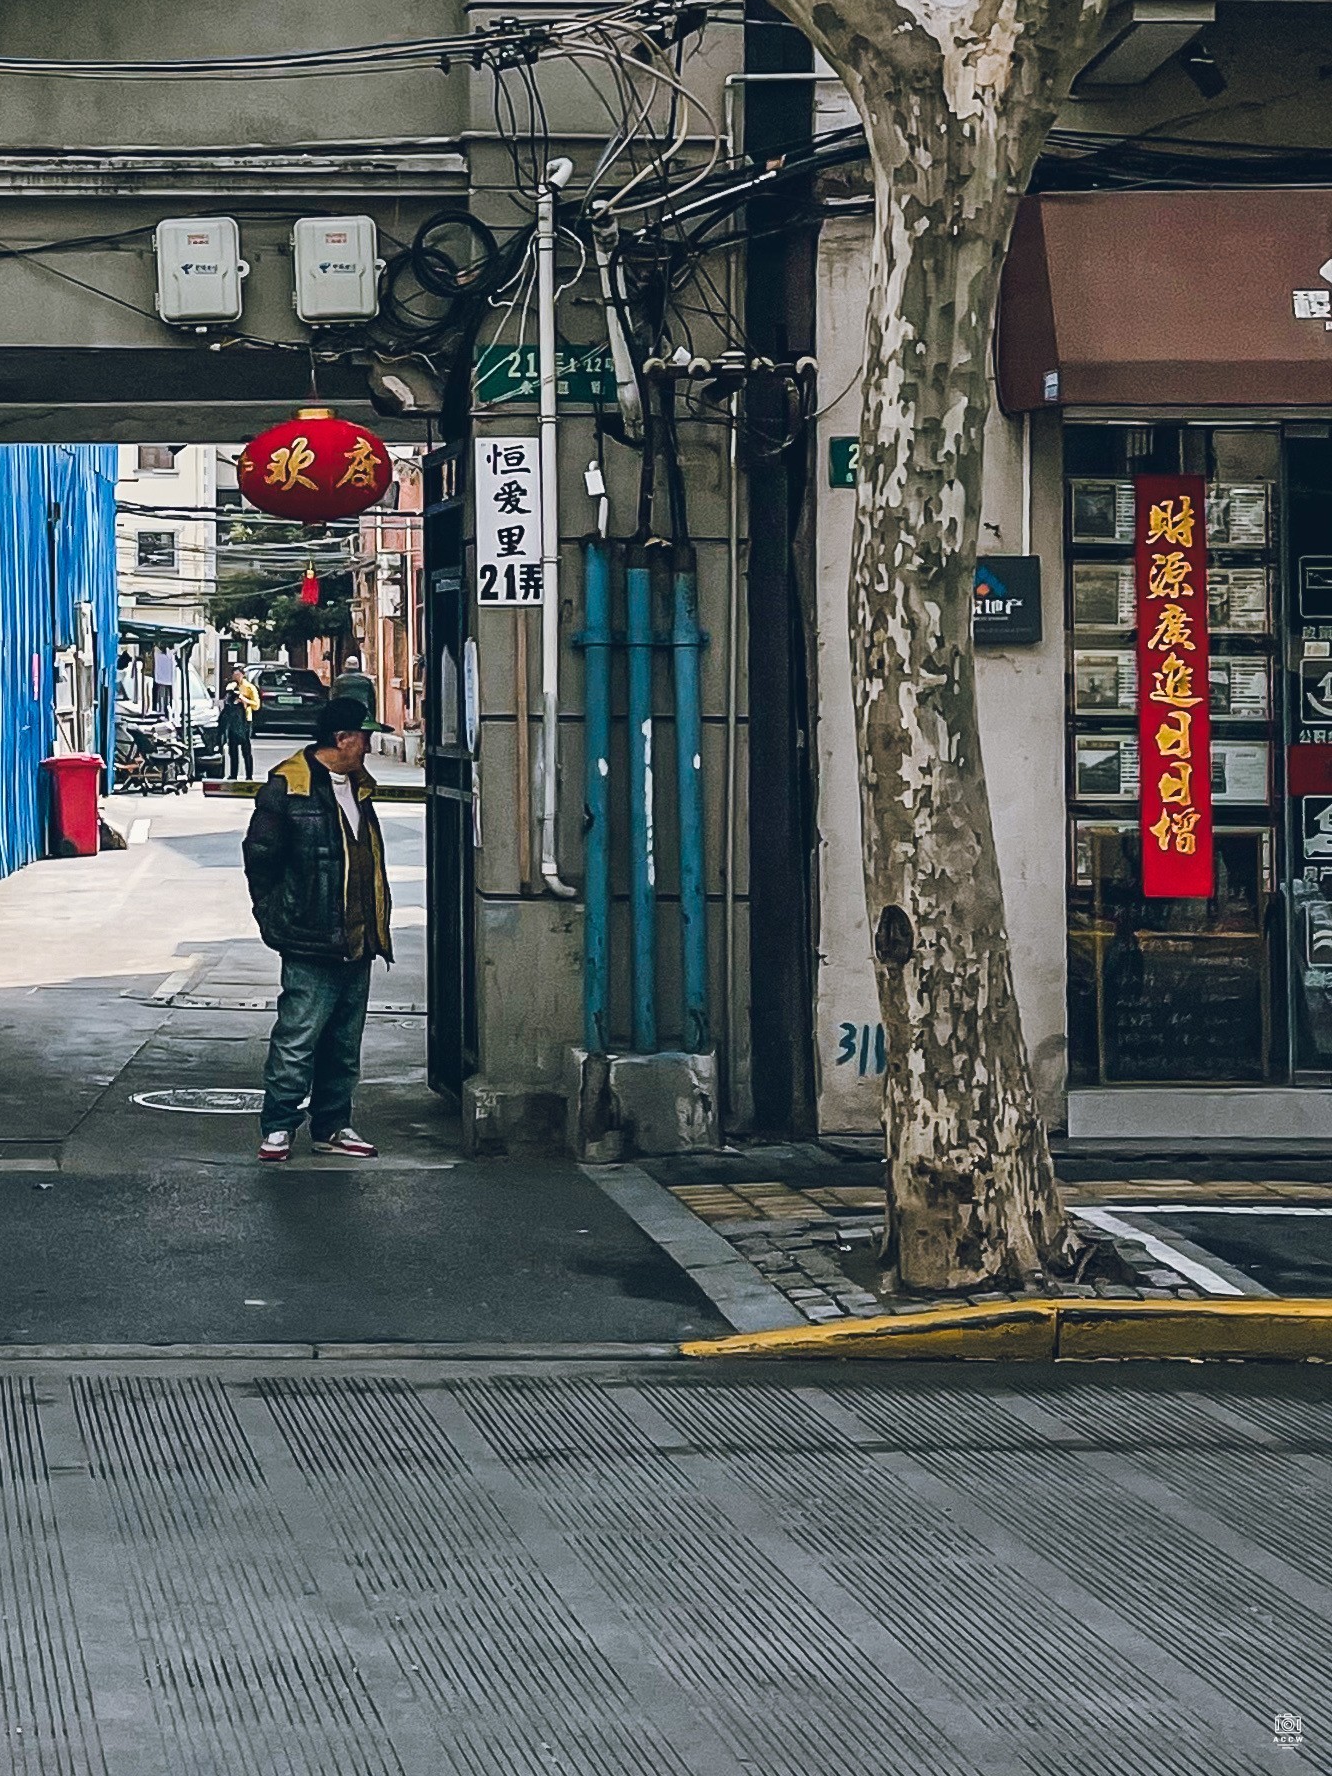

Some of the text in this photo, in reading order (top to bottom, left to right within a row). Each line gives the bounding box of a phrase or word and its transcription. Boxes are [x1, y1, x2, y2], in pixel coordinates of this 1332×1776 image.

[486, 443, 532, 558] 恒爱里
[479, 563, 544, 601] 21弄
